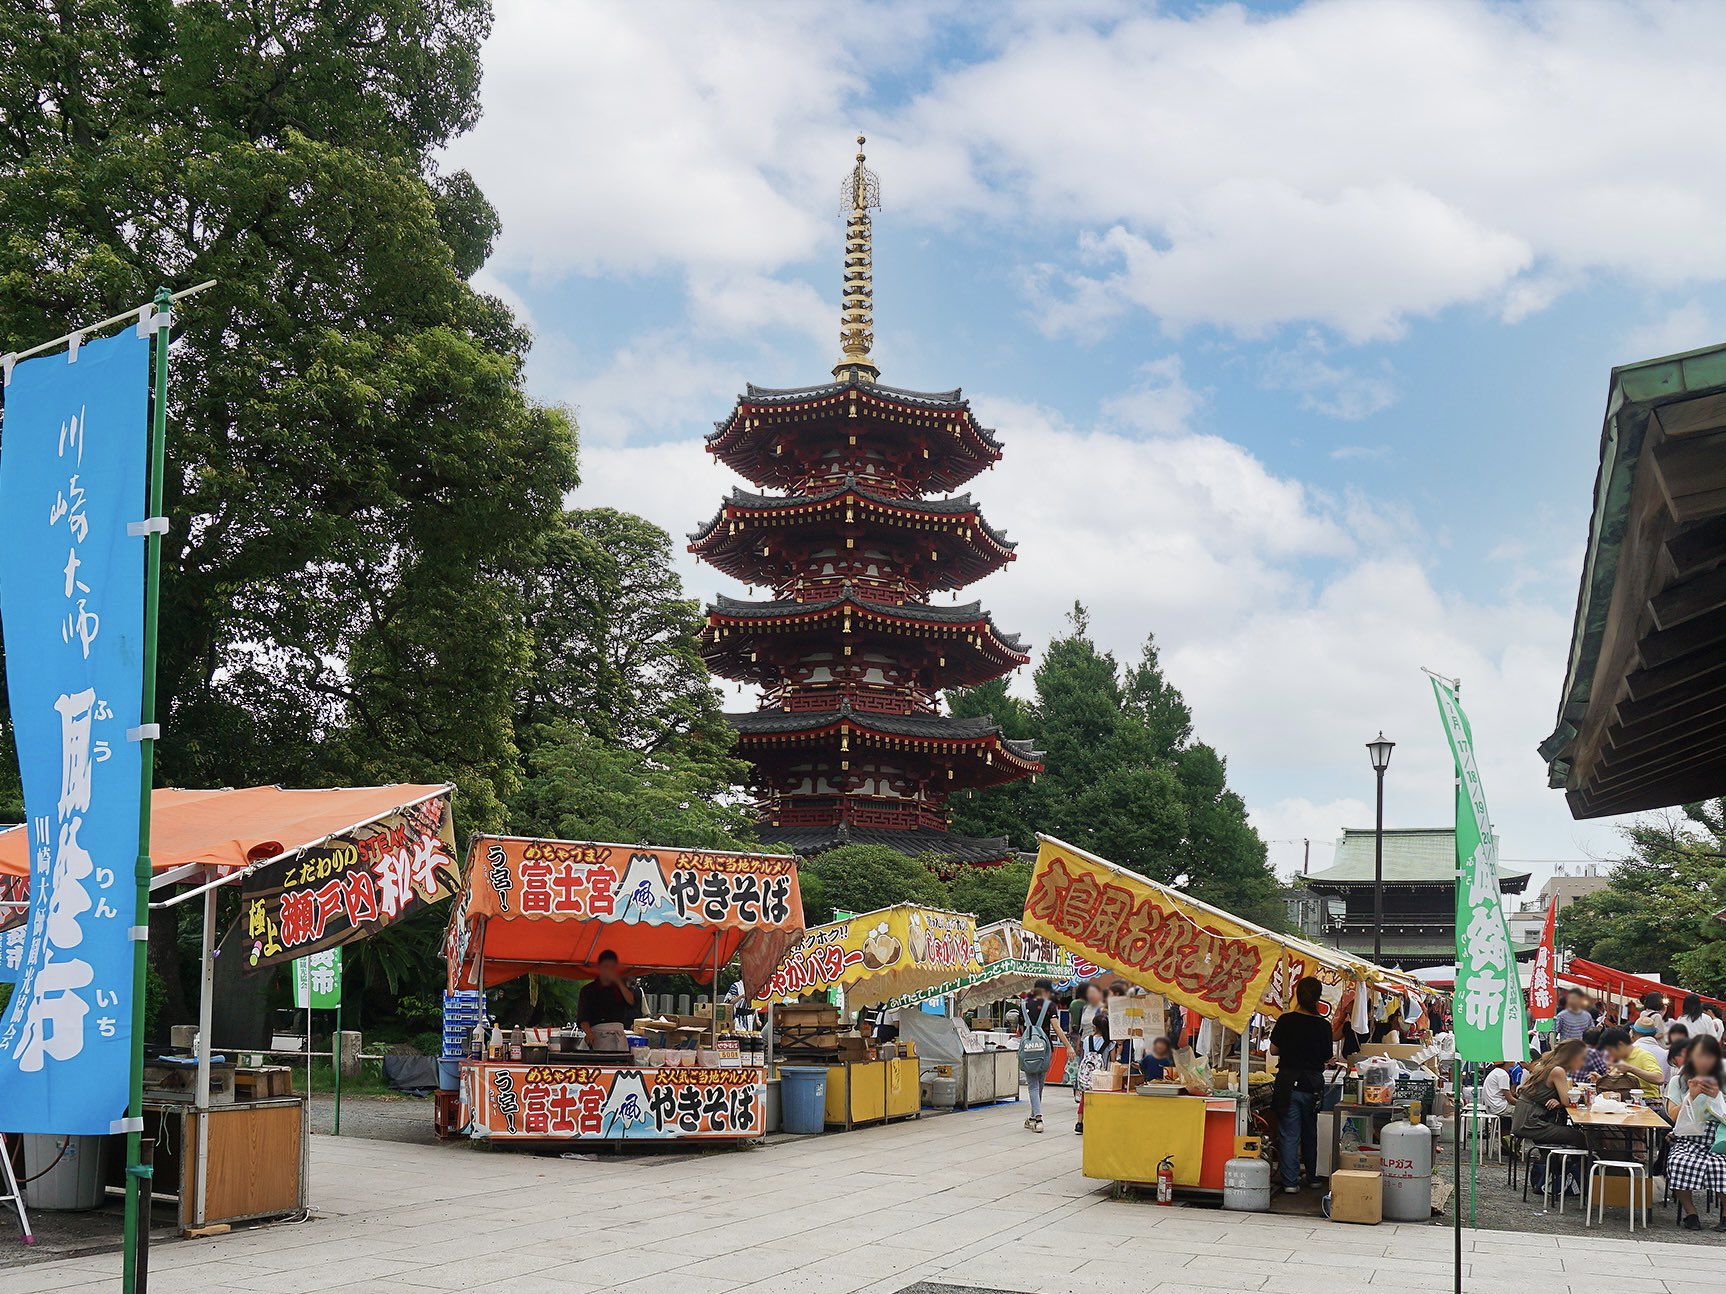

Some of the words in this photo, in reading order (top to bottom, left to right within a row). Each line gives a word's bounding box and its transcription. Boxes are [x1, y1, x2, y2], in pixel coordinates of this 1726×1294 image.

[50, 404, 99, 660] 川崎大師
[93, 700, 113, 762] ふう
[284, 845, 358, 888] こだわりの
[357, 823, 408, 862] STEAK
[675, 853, 793, 876] 大人気ご当地グルメ!
[96, 867, 117, 919] りん
[519, 860, 618, 918] 富士宮
[668, 869, 792, 925] やきそば
[249, 898, 282, 957] 極上
[96, 989, 118, 1037] いち
[656, 1069, 757, 1085] 大人気ご当地グルメ!
[522, 1084, 607, 1135] 富士宮
[649, 1084, 755, 1133] やきそば
